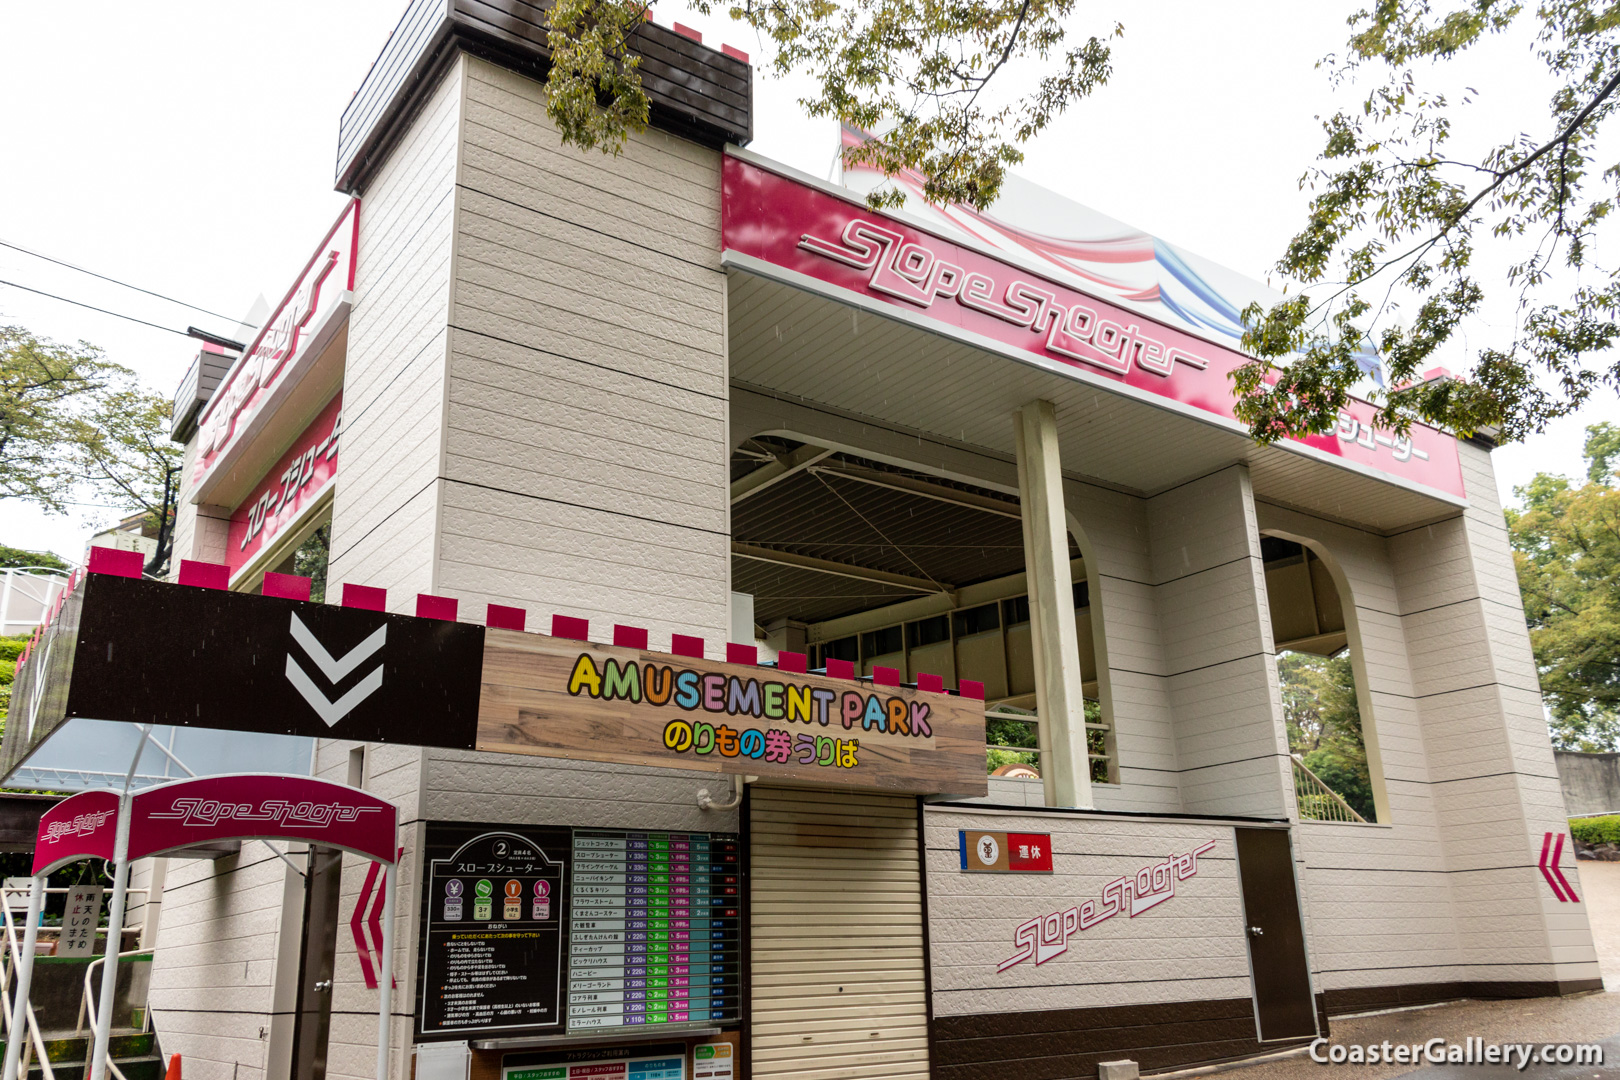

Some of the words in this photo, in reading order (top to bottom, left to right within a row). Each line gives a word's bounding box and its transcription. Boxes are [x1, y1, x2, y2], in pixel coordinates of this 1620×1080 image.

[797, 217, 998, 307] Slope
[1004, 277, 1209, 377] Shooter
[567, 652, 835, 726] AMUSEMENT
[841, 693, 932, 738] PARK
[148, 797, 252, 826] Slope
[259, 800, 383, 828] Shooter
[456, 863, 542, 874] スロープシューター
[496, 842, 506, 855] 2
[1018, 845, 1041, 859] 運休
[67, 892, 84, 950] 休止します
[78, 893, 96, 949] 雨天のため
[997, 899, 1095, 974] Slope
[1102, 839, 1216, 918] Shooter
